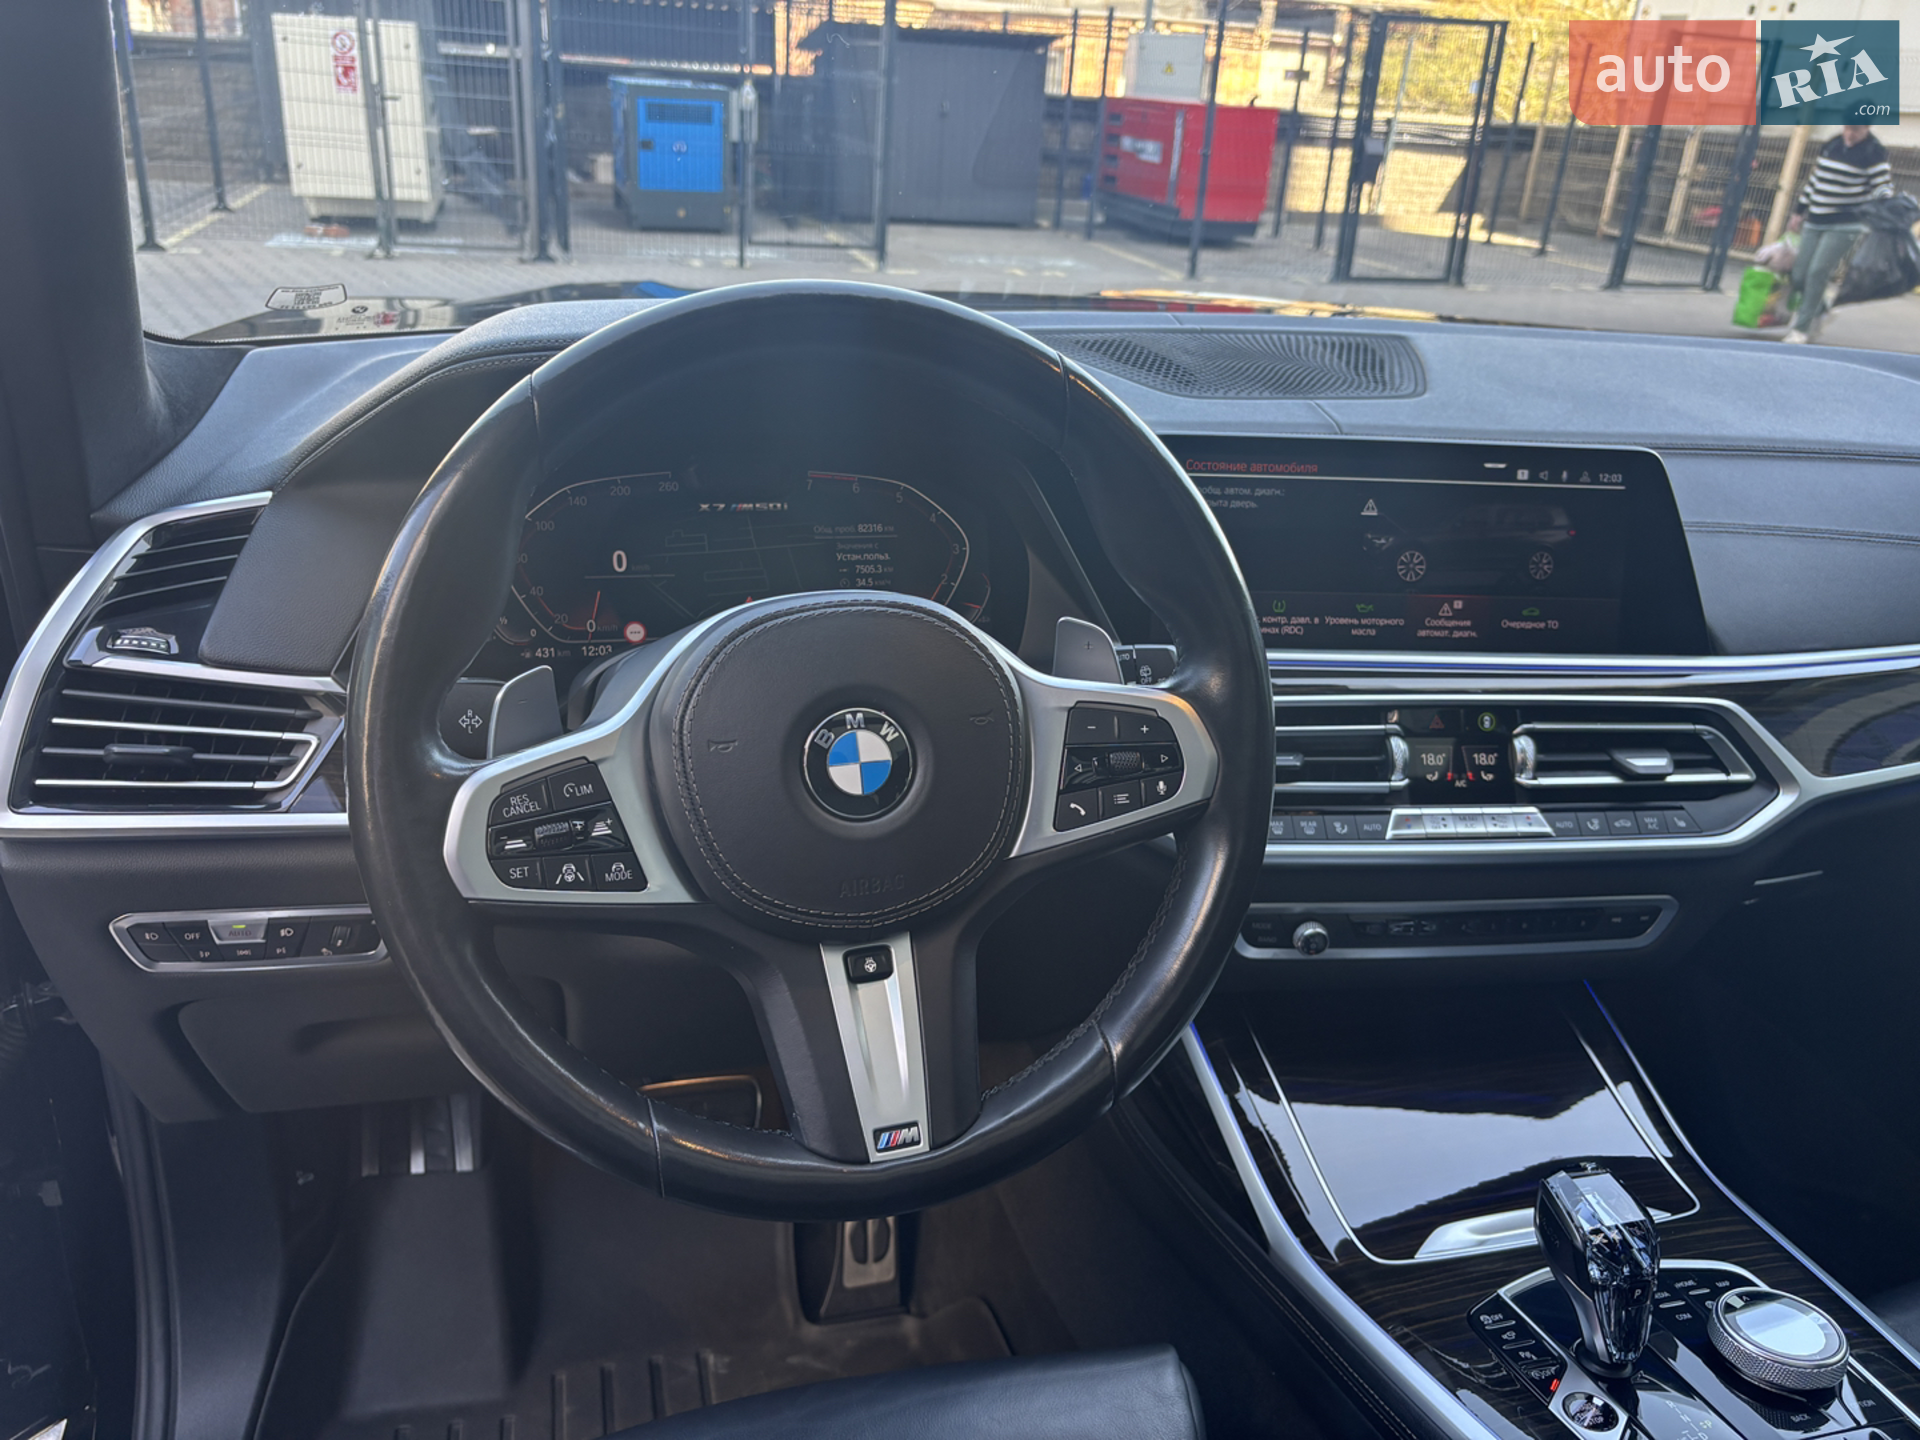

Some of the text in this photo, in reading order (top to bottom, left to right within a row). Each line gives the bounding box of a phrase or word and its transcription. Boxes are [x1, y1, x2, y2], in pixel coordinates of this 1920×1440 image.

[1186, 459, 1318, 473] Состояние автомобиля
[1599, 474, 1623, 483] 12:03
[658, 482, 679, 492] 260
[806, 479, 813, 491] 7
[852, 482, 860, 493] 6
[610, 486, 631, 496] 200
[569, 496, 587, 506] 140
[896, 492, 903, 503] 5
[698, 503, 726, 512] X7
[929, 513, 936, 524] 4
[535, 521, 555, 531] 100
[857, 524, 883, 533] 82316
[952, 544, 960, 554] 3
[612, 549, 628, 573] 0
[855, 565, 883, 574] 7505.3
[855, 578, 874, 587] 34.5
[940, 574, 948, 585] 2
[530, 586, 544, 596] 40
[554, 613, 569, 624] 20
[1324, 616, 1405, 627] Уровень моторного
[1425, 617, 1471, 628] Сообщения
[586, 619, 596, 632] 0
[1501, 620, 1559, 629] Очередное ТО
[1281, 626, 1304, 635] (RDC)
[1351, 628, 1376, 636] масла
[535, 648, 555, 657] 431
[581, 645, 612, 656] 12:03
[467, 709, 473, 718] R
[814, 712, 900, 749] BMW
[1455, 780, 1467, 788] A/C
[575, 783, 594, 797] LIM
[510, 793, 529, 807] RES
[502, 802, 542, 818] CANCEL
[509, 866, 529, 879] SET
[604, 869, 633, 882] MODE
[839, 875, 905, 898] AIRBAG
[184, 932, 200, 940] OFF
[1634, 1289, 1641, 1299] P
[1791, 1413, 1810, 1423] BACK
